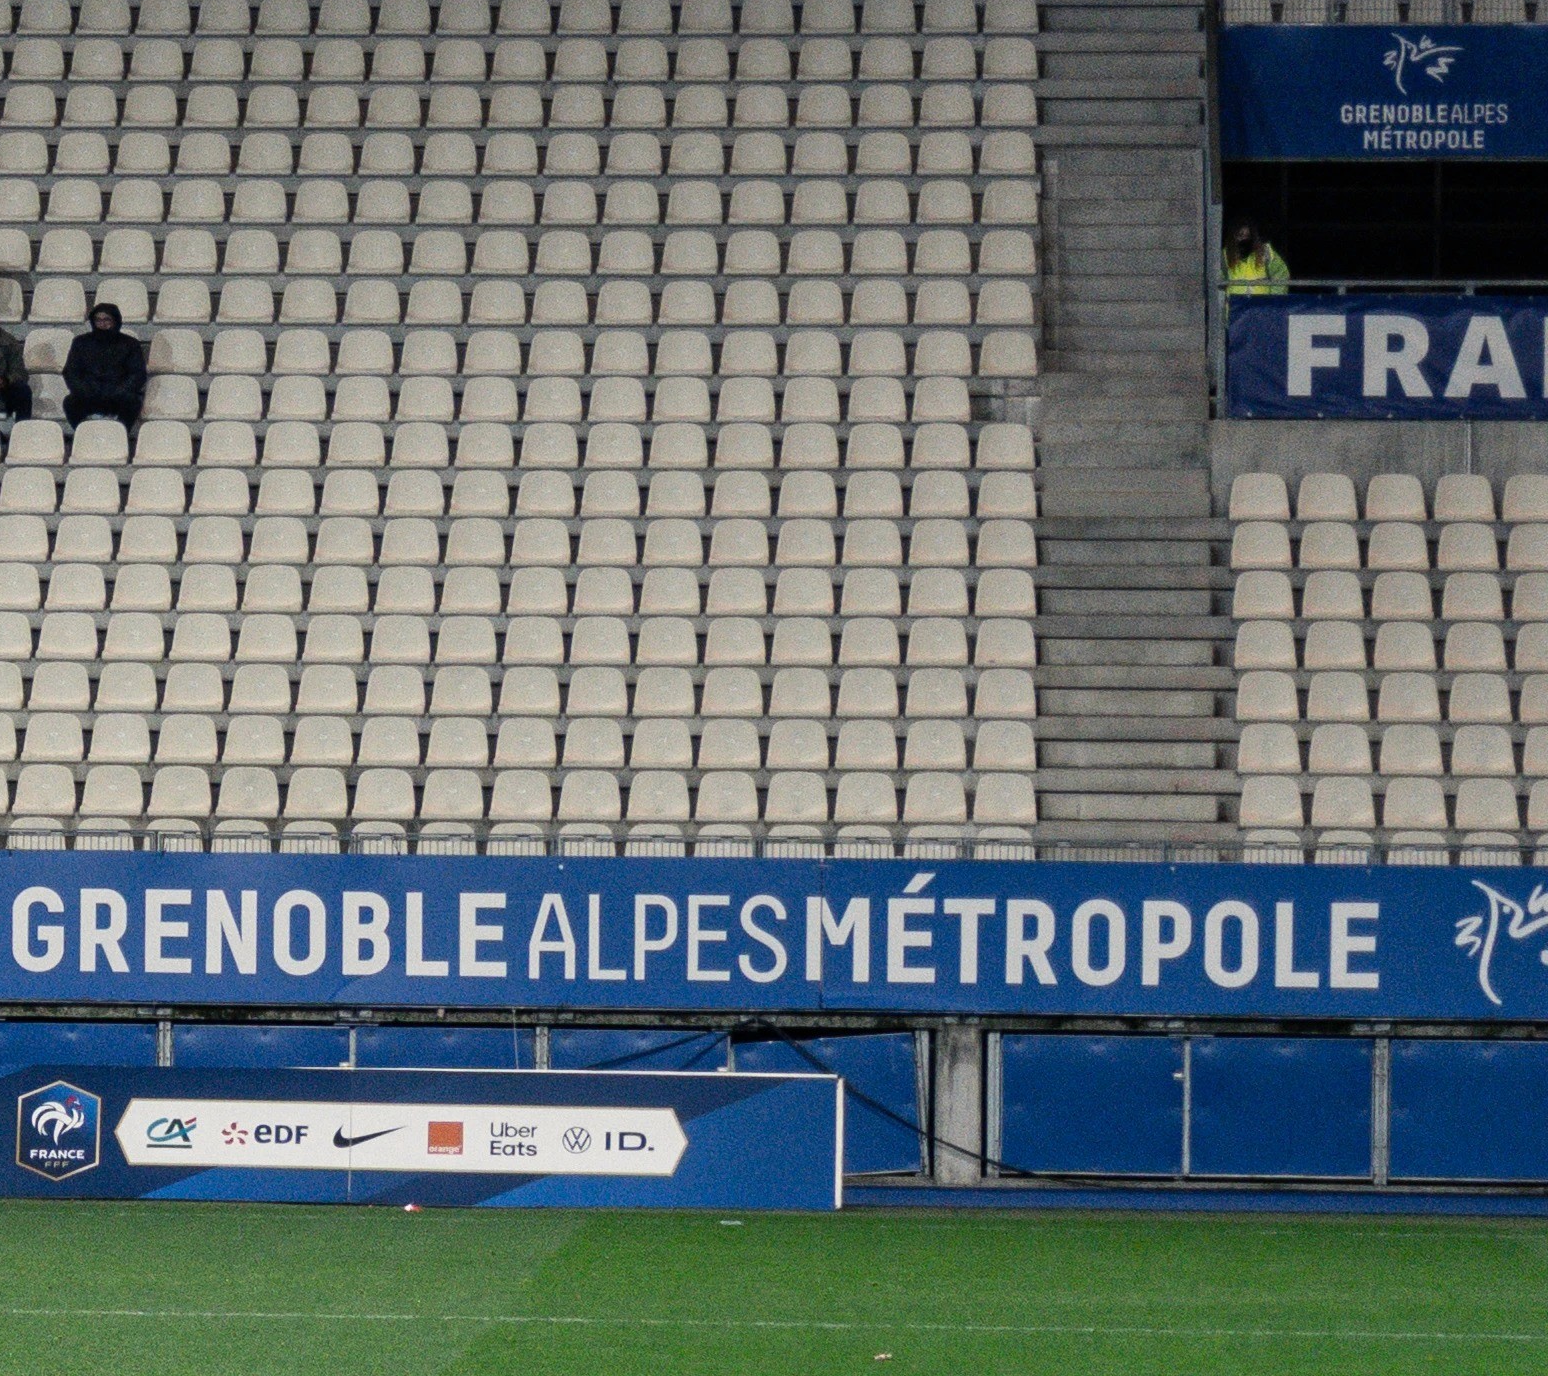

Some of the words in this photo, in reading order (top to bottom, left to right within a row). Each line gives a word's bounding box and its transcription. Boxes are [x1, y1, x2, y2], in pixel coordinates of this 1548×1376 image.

[1363, 125, 1486, 150] MÉTROPOLE
[1287, 314, 1548, 399] FRA
[489, 1121, 537, 1138] Uber
[29, 1149, 85, 1160] FRANCE
[427, 1146, 460, 1154] orange
[489, 1140, 537, 1157] Eats
